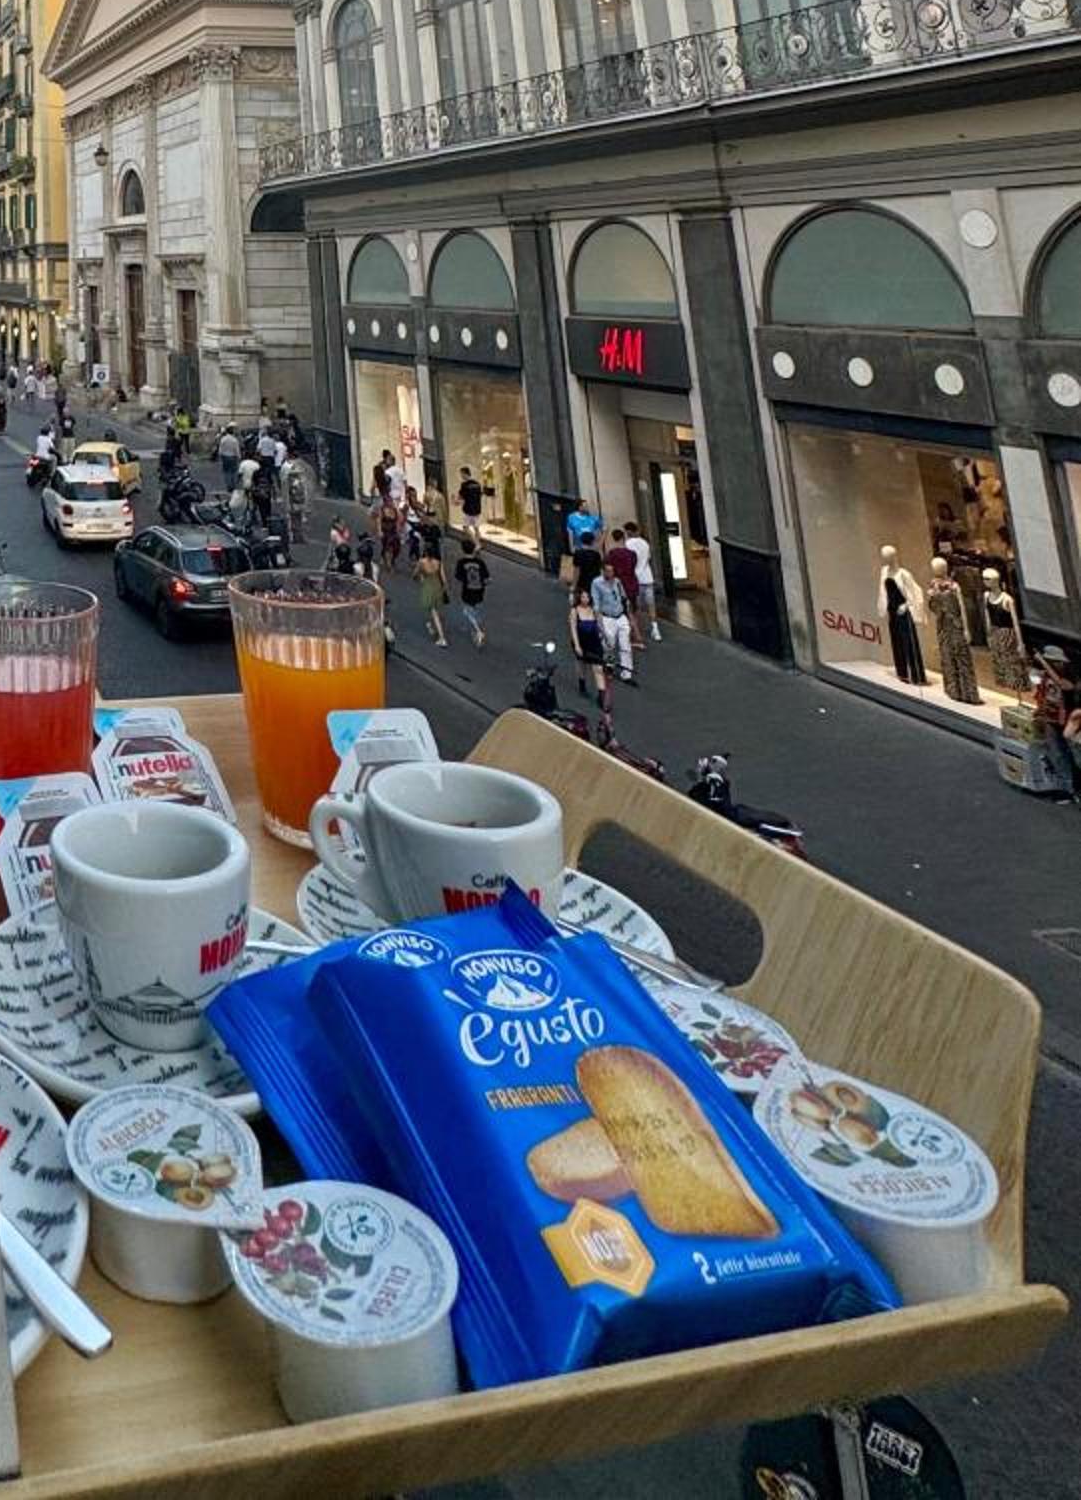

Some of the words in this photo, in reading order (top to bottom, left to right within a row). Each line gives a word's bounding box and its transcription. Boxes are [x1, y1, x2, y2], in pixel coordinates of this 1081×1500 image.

[822, 609, 882, 645] SALDI
[118, 754, 194, 777] nutella
[365, 933, 434, 957] ONVISO
[458, 956, 542, 984] MONVISO
[692, 1251, 717, 1285] 2
